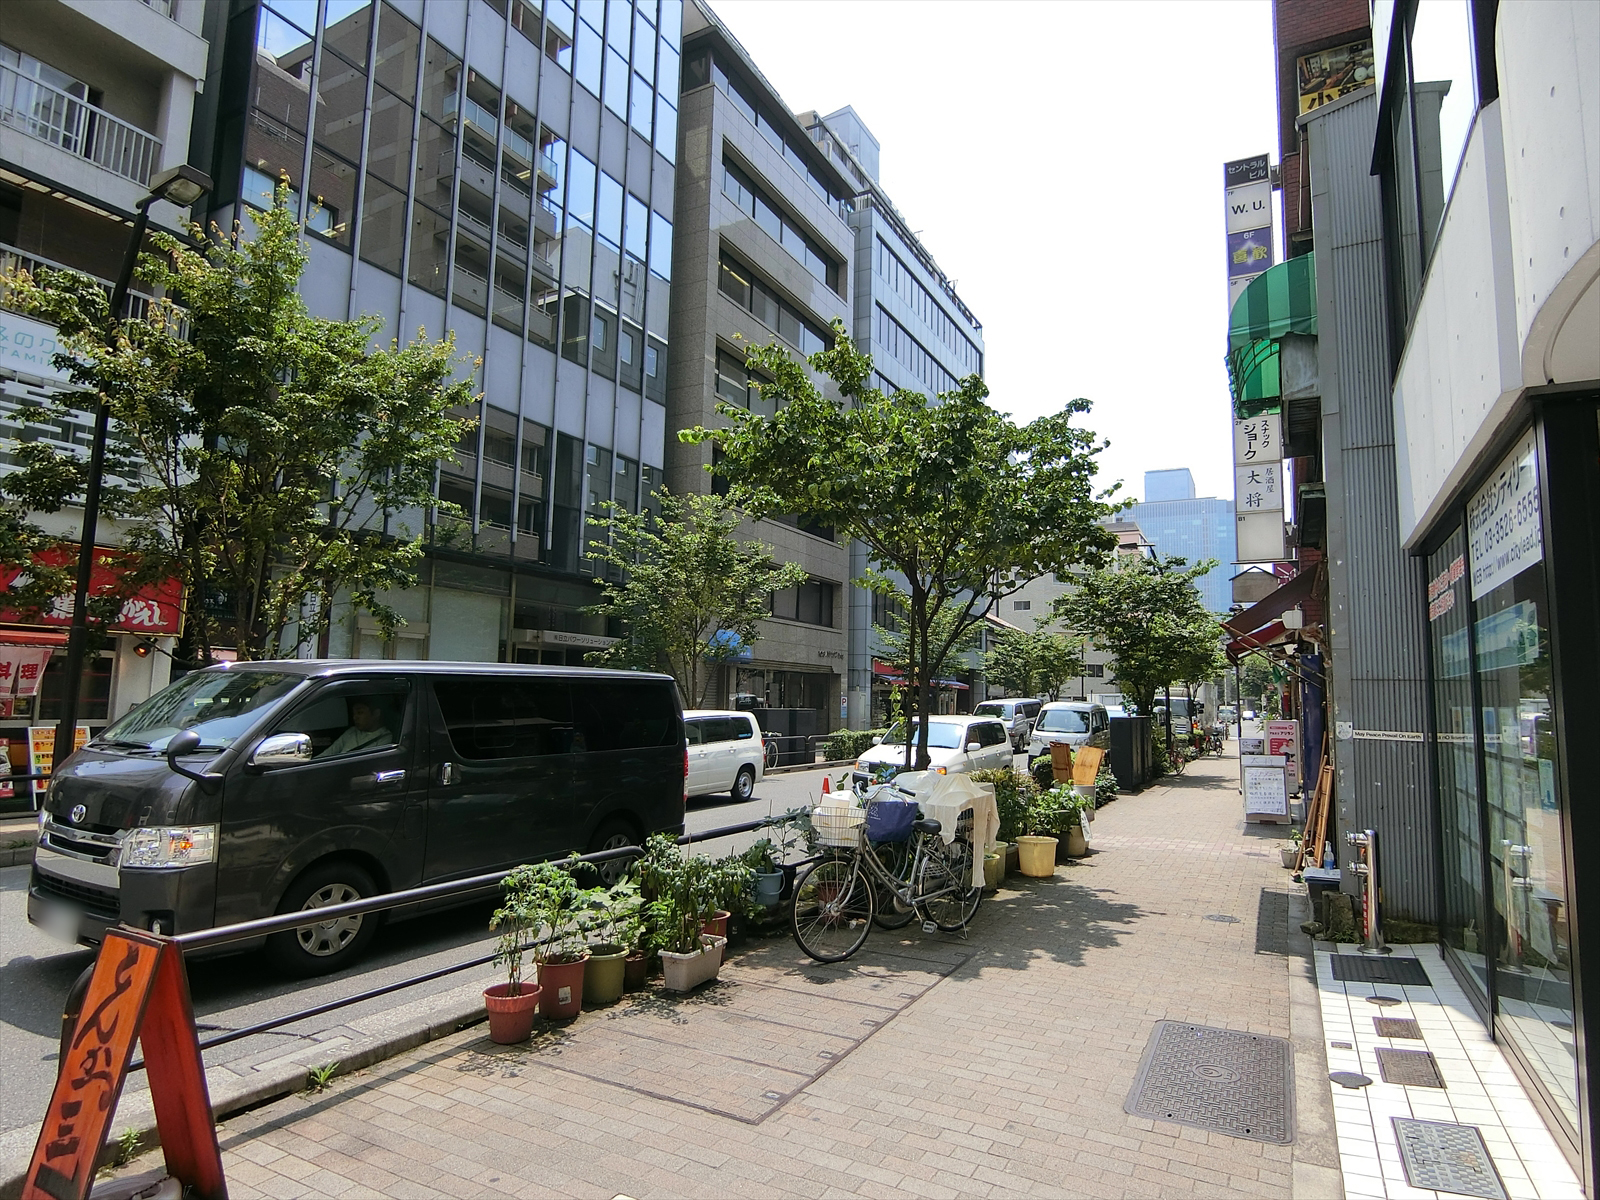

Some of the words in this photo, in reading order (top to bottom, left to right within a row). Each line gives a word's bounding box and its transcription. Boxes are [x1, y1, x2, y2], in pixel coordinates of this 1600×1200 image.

[1228, 160, 1266, 174] セントラル
[1249, 169, 1266, 180] ビル
[1243, 231, 1255, 240] 6F
[1243, 423, 1257, 461] ジョーク
[1260, 419, 1270, 449] スナック
[1245, 470, 1264, 508] 大将
[1264, 467, 1275, 494] 居酒屋
[1471, 540, 1483, 564] TEL
